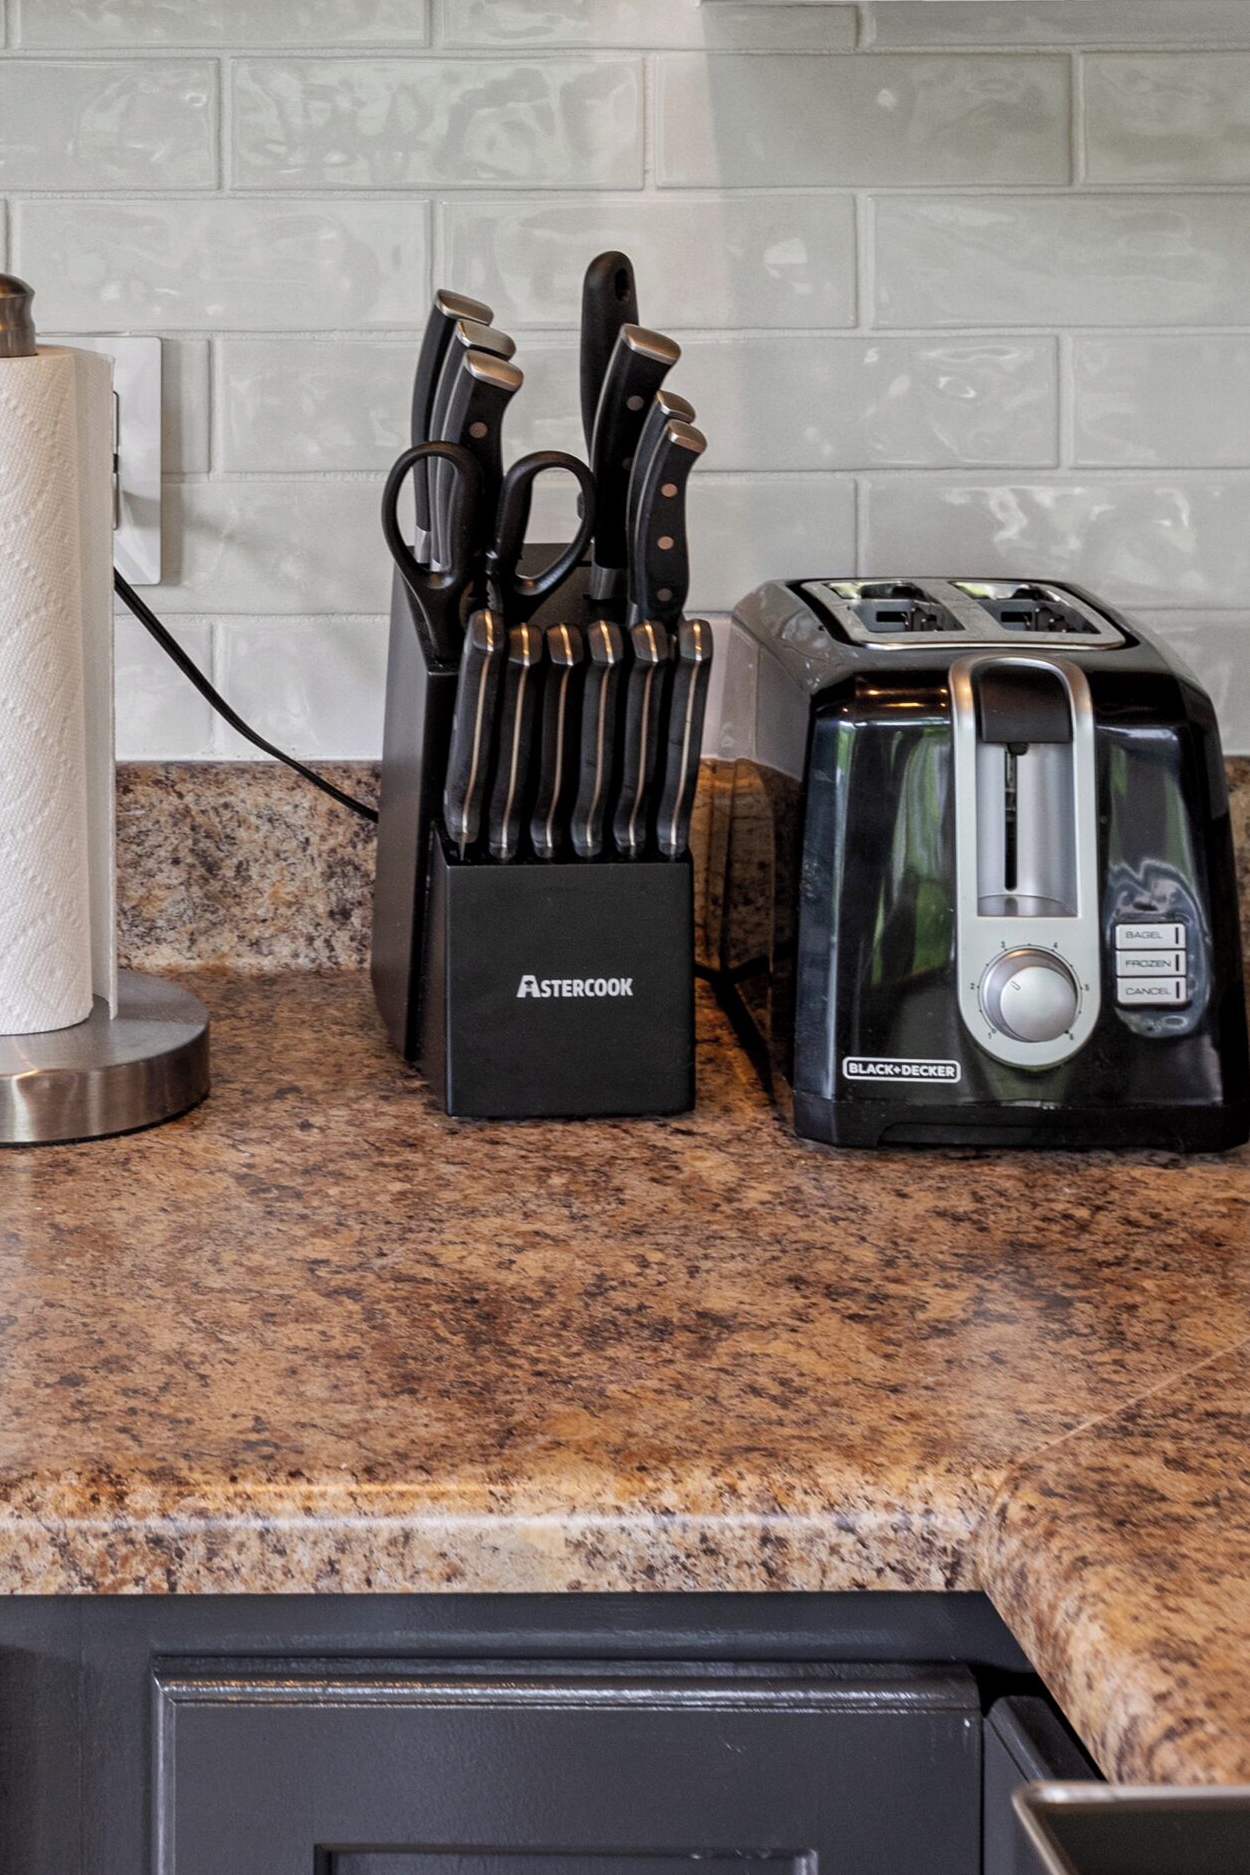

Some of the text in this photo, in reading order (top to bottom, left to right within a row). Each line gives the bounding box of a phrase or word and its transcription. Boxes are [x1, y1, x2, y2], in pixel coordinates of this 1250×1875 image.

[1125, 930, 1164, 940] BAGEL
[1125, 958, 1172, 968] FROZEN
[516, 974, 634, 999] ASTERCOOK
[1125, 986, 1172, 996] CANCEL
[848, 1062, 956, 1078] BLACK+DECKER
